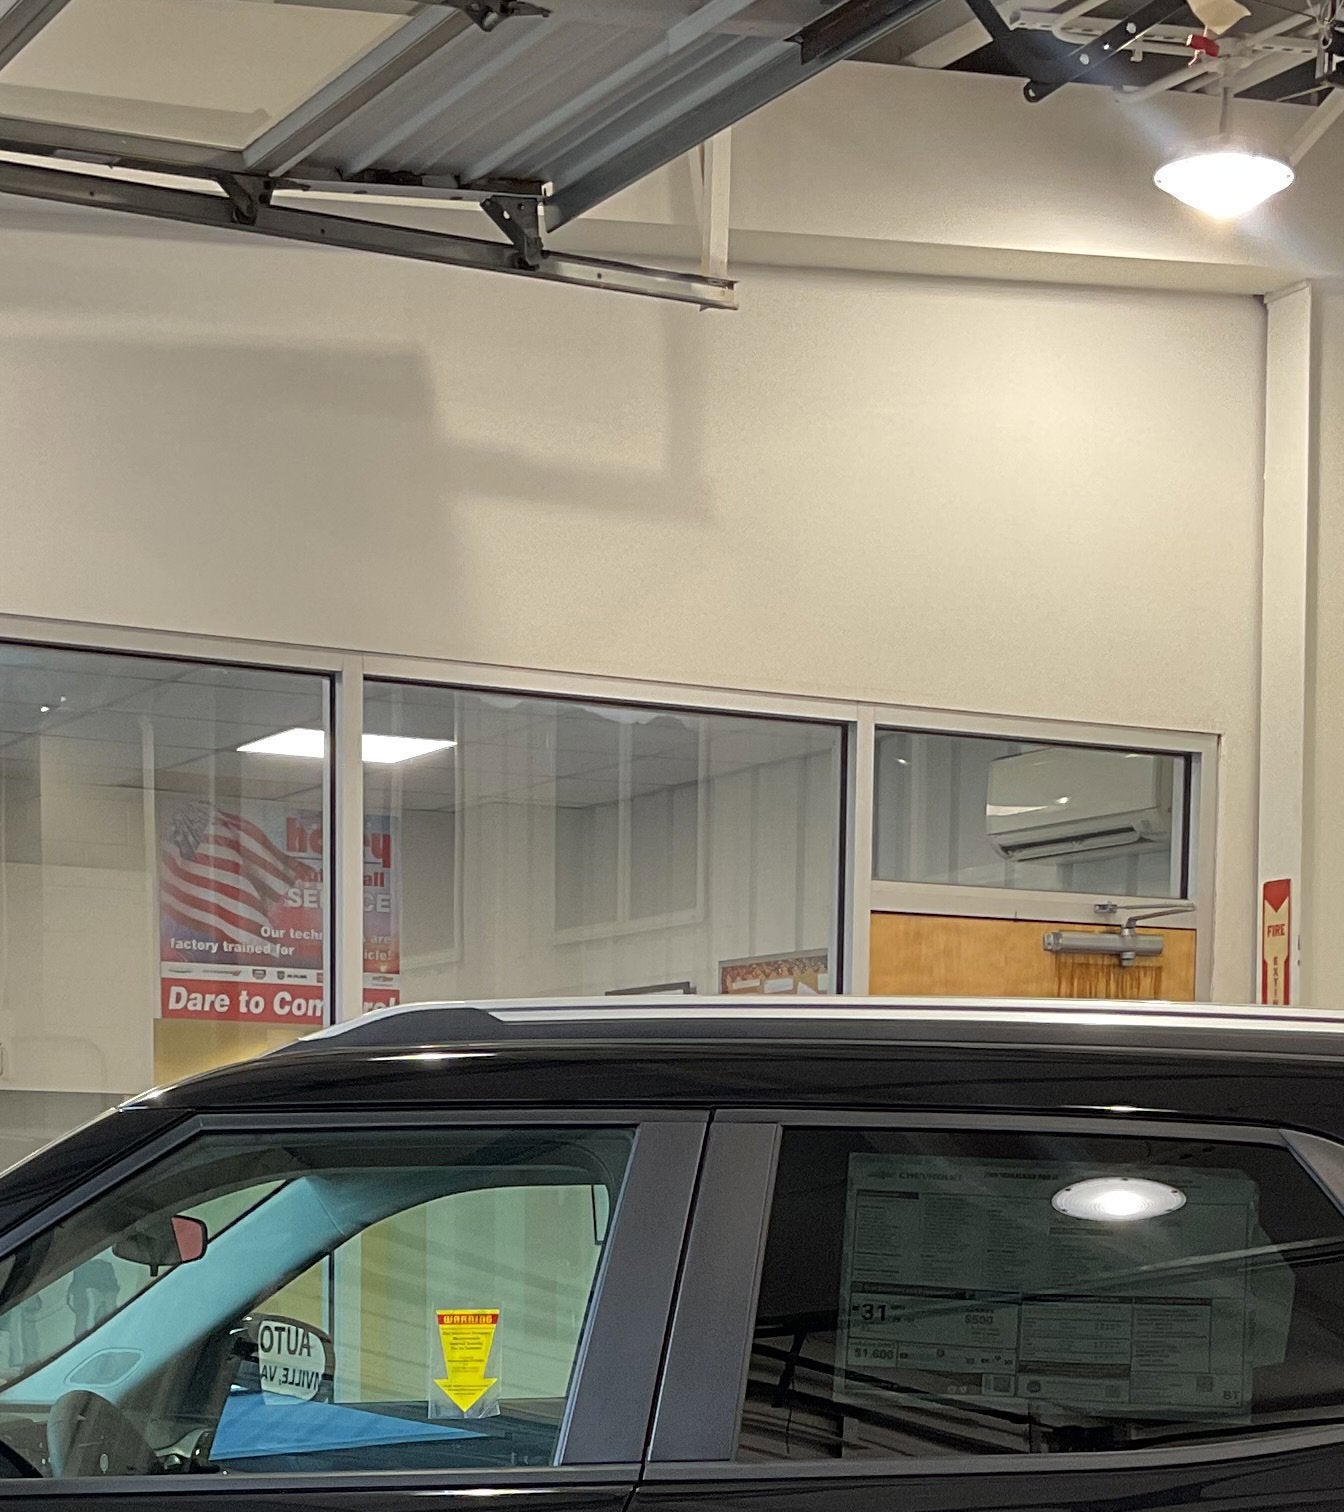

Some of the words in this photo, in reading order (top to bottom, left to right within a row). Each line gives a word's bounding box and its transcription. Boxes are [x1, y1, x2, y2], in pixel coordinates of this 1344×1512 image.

[260, 926, 286, 938] Our
[1267, 924, 1285, 937] FIRE
[170, 937, 219, 953] factory
[223, 940, 271, 955] trained
[276, 943, 295, 956] for
[168, 986, 230, 1013] Dare
[239, 989, 265, 1014] to
[443, 1315, 493, 1325] WARNING
